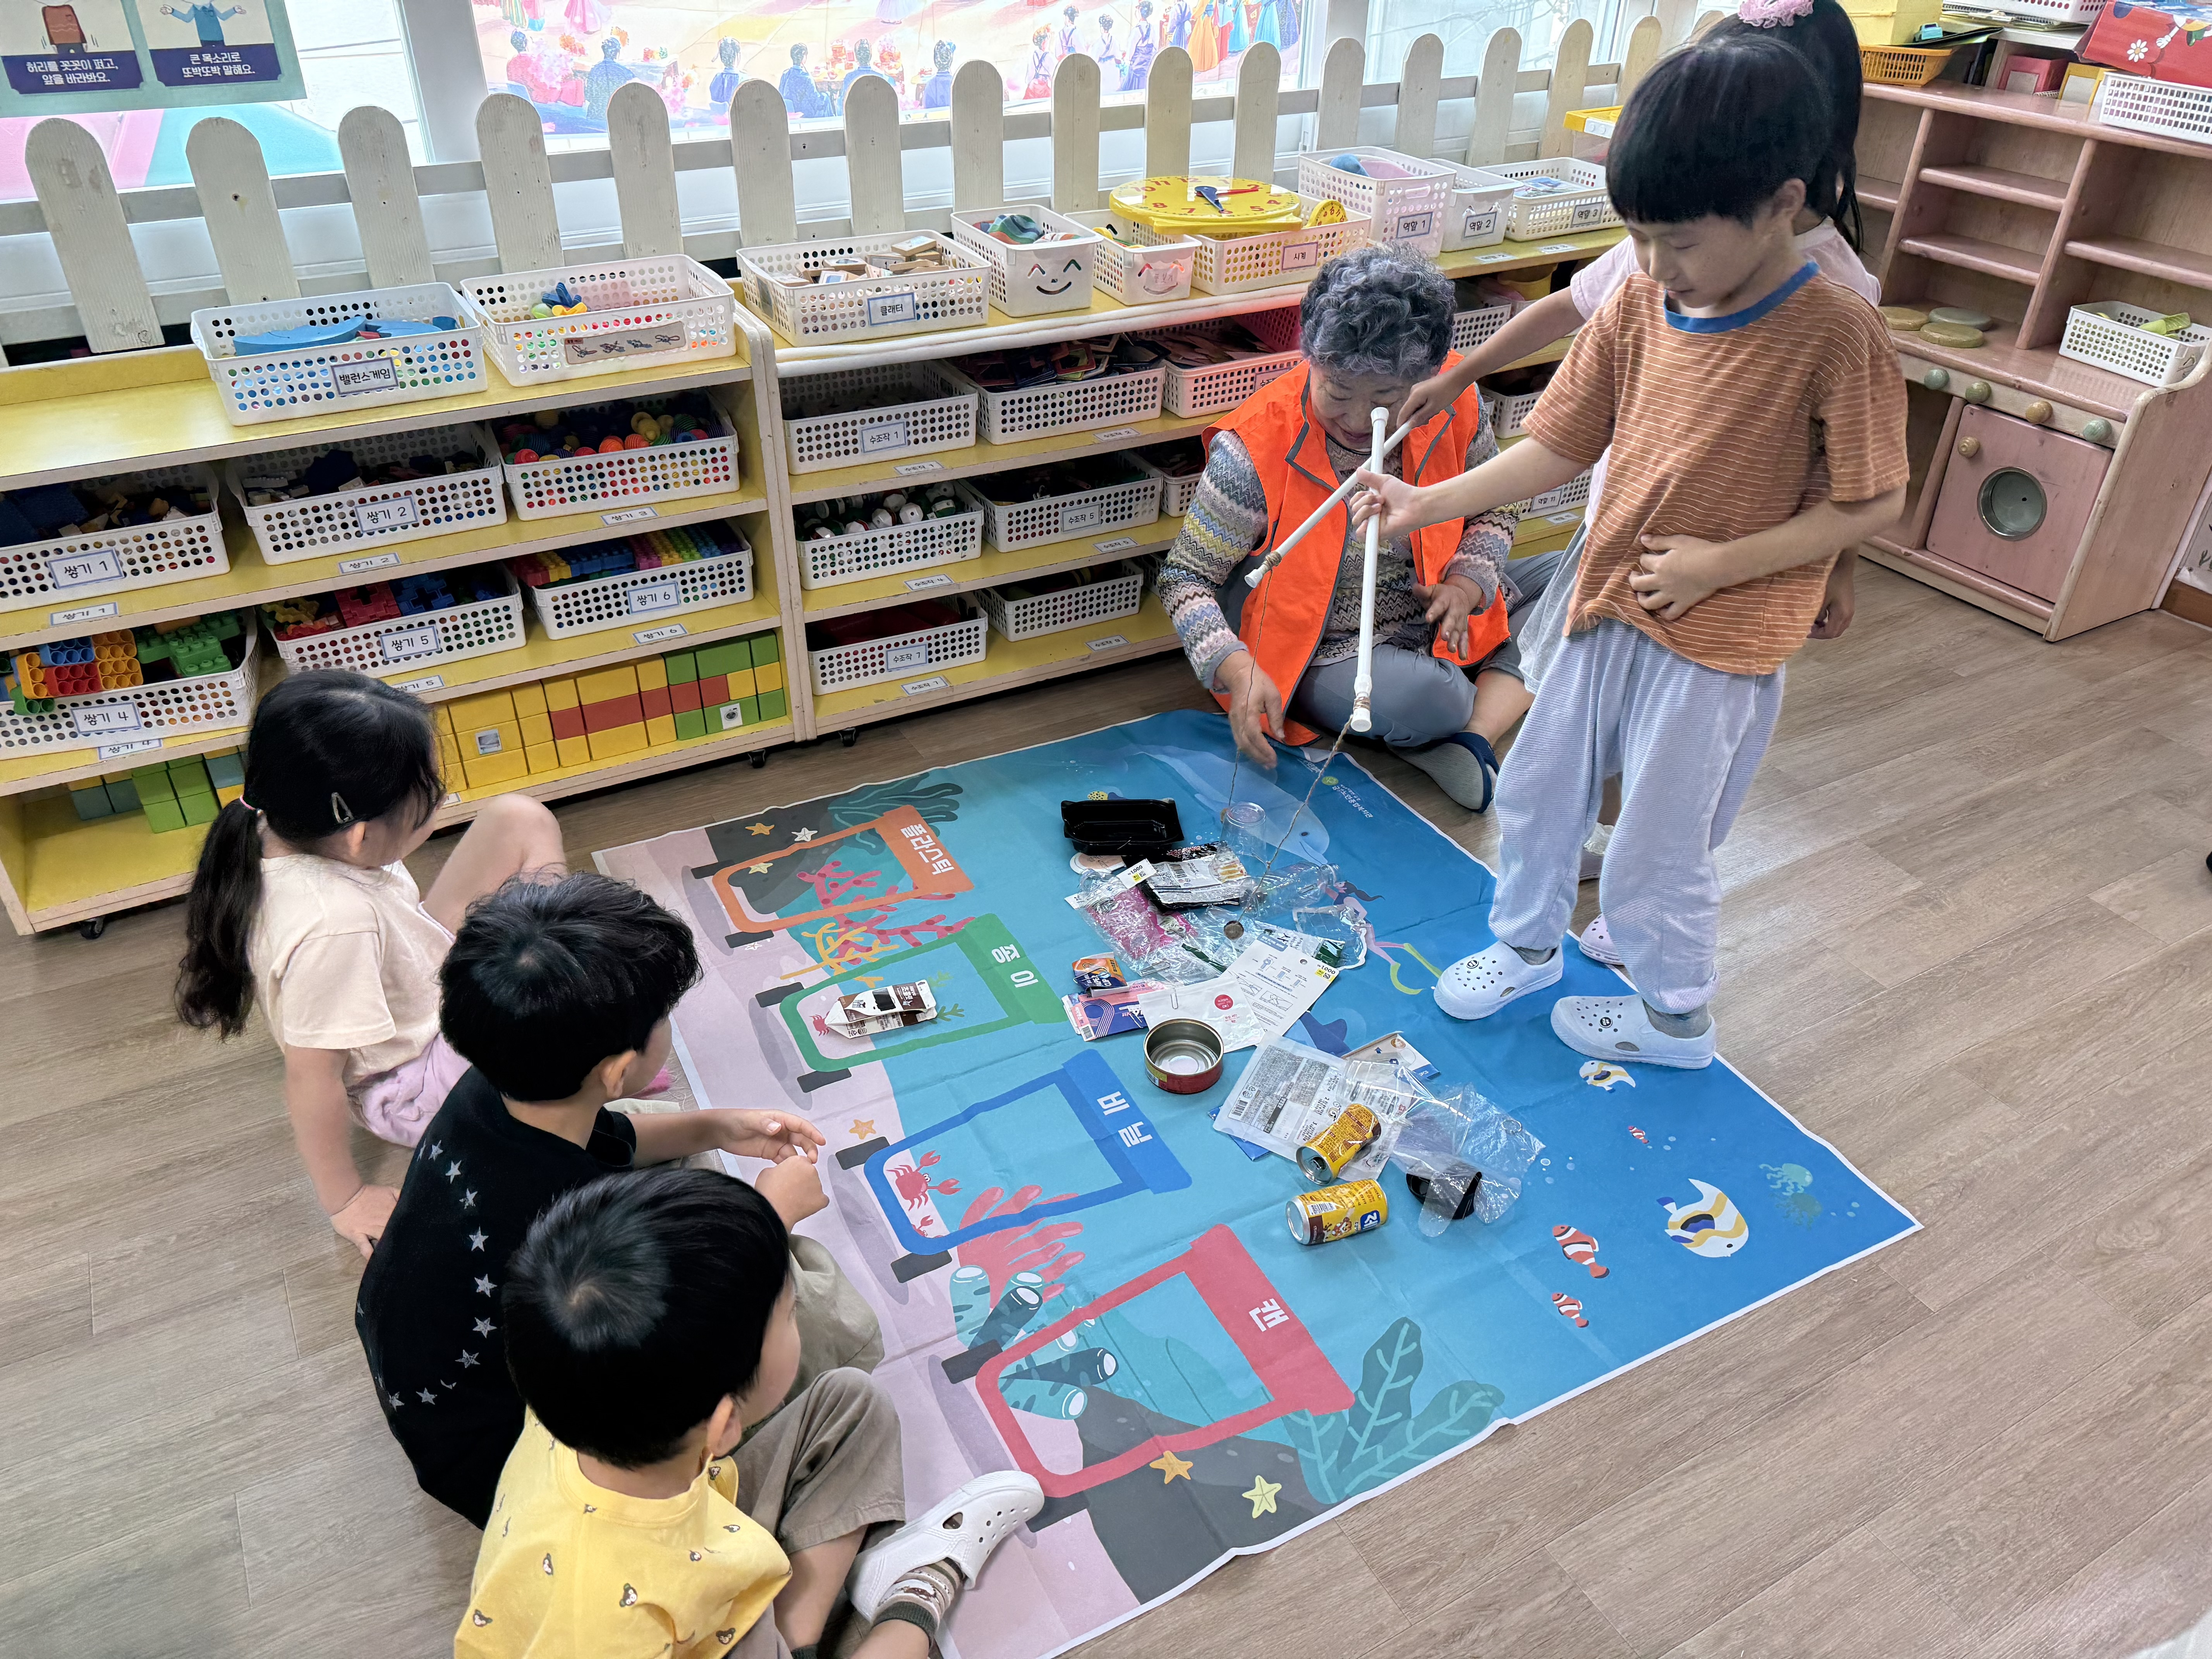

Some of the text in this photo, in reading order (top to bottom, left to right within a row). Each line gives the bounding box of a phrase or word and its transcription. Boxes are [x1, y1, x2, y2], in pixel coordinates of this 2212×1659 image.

[26, 58, 118, 72] 허리를 꼿꼿이 펴고,
[190, 52, 242, 65] 큰 목소리로
[182, 64, 256, 78] 또박또박 말해요.
[42, 72, 111, 85] 앞을 바라봐요.
[1592, 209, 1597, 217] 3
[1486, 220, 1491, 228] 2
[1294, 252, 1306, 260] 시계
[880, 304, 903, 316] 클래터
[339, 368, 390, 385] 밸런스게임
[870, 433, 890, 444] 수조작
[368, 507, 407, 524] 쌓기 2
[1069, 514, 1086, 524] 수조작
[64, 560, 108, 579] 쌓기 1
[637, 591, 670, 605] 쌓기 6
[392, 635, 429, 651] 쌓기 5
[893, 653, 912, 663] 수조작
[84, 711, 129, 726] 쌓기 4
[900, 823, 954, 876] 플라스틱
[1097, 1091, 1153, 1147] 비닐
[1249, 1298, 1290, 1332] 캔
